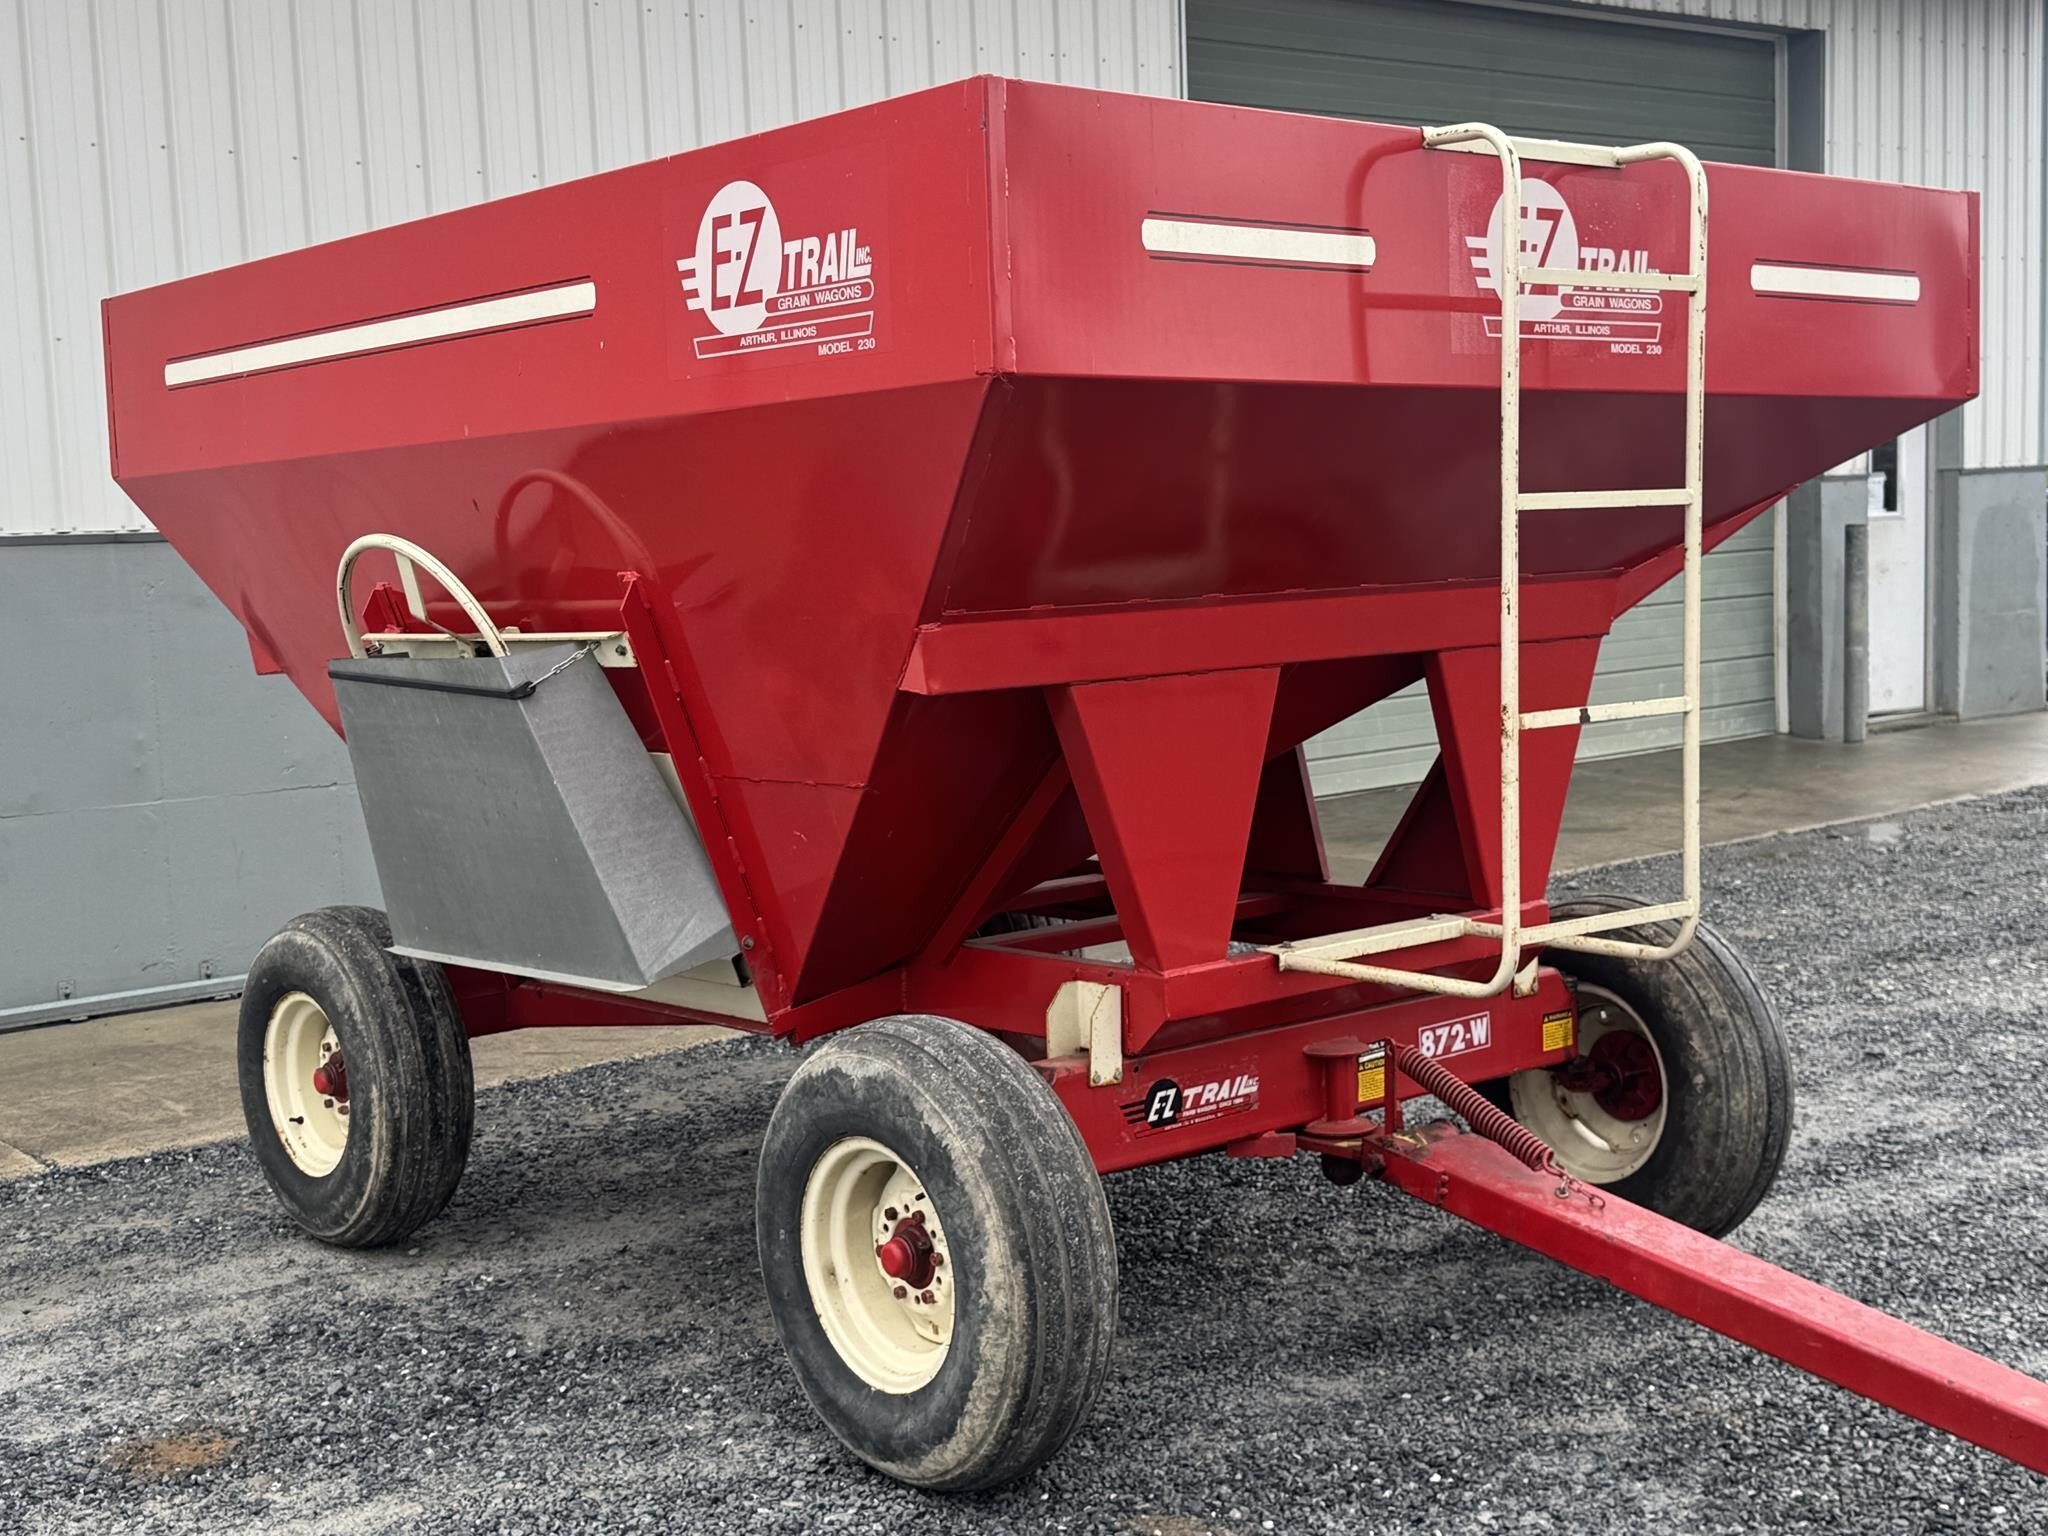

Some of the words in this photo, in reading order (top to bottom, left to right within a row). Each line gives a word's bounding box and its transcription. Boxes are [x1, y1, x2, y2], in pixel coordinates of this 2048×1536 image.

[783, 228, 872, 290] TRAIL
[777, 293, 810, 310] GRAIN
[815, 285, 862, 304] WAGONS
[1573, 296, 1604, 308] GRAIN
[1609, 298, 1651, 310] WAGONS
[740, 332, 777, 347] ARTHUR,
[781, 326, 817, 341] ILLINOIS
[1533, 324, 1572, 335] ARTHUR,
[1575, 325, 1610, 335] ILLINOIS
[818, 341, 853, 356] MODEL
[858, 338, 875, 350] 230
[1611, 344, 1642, 354] MODEL
[1646, 345, 1662, 355] 230
[1421, 1017, 1488, 1058] 872-W
[1183, 1075, 1258, 1109] TRAIL
